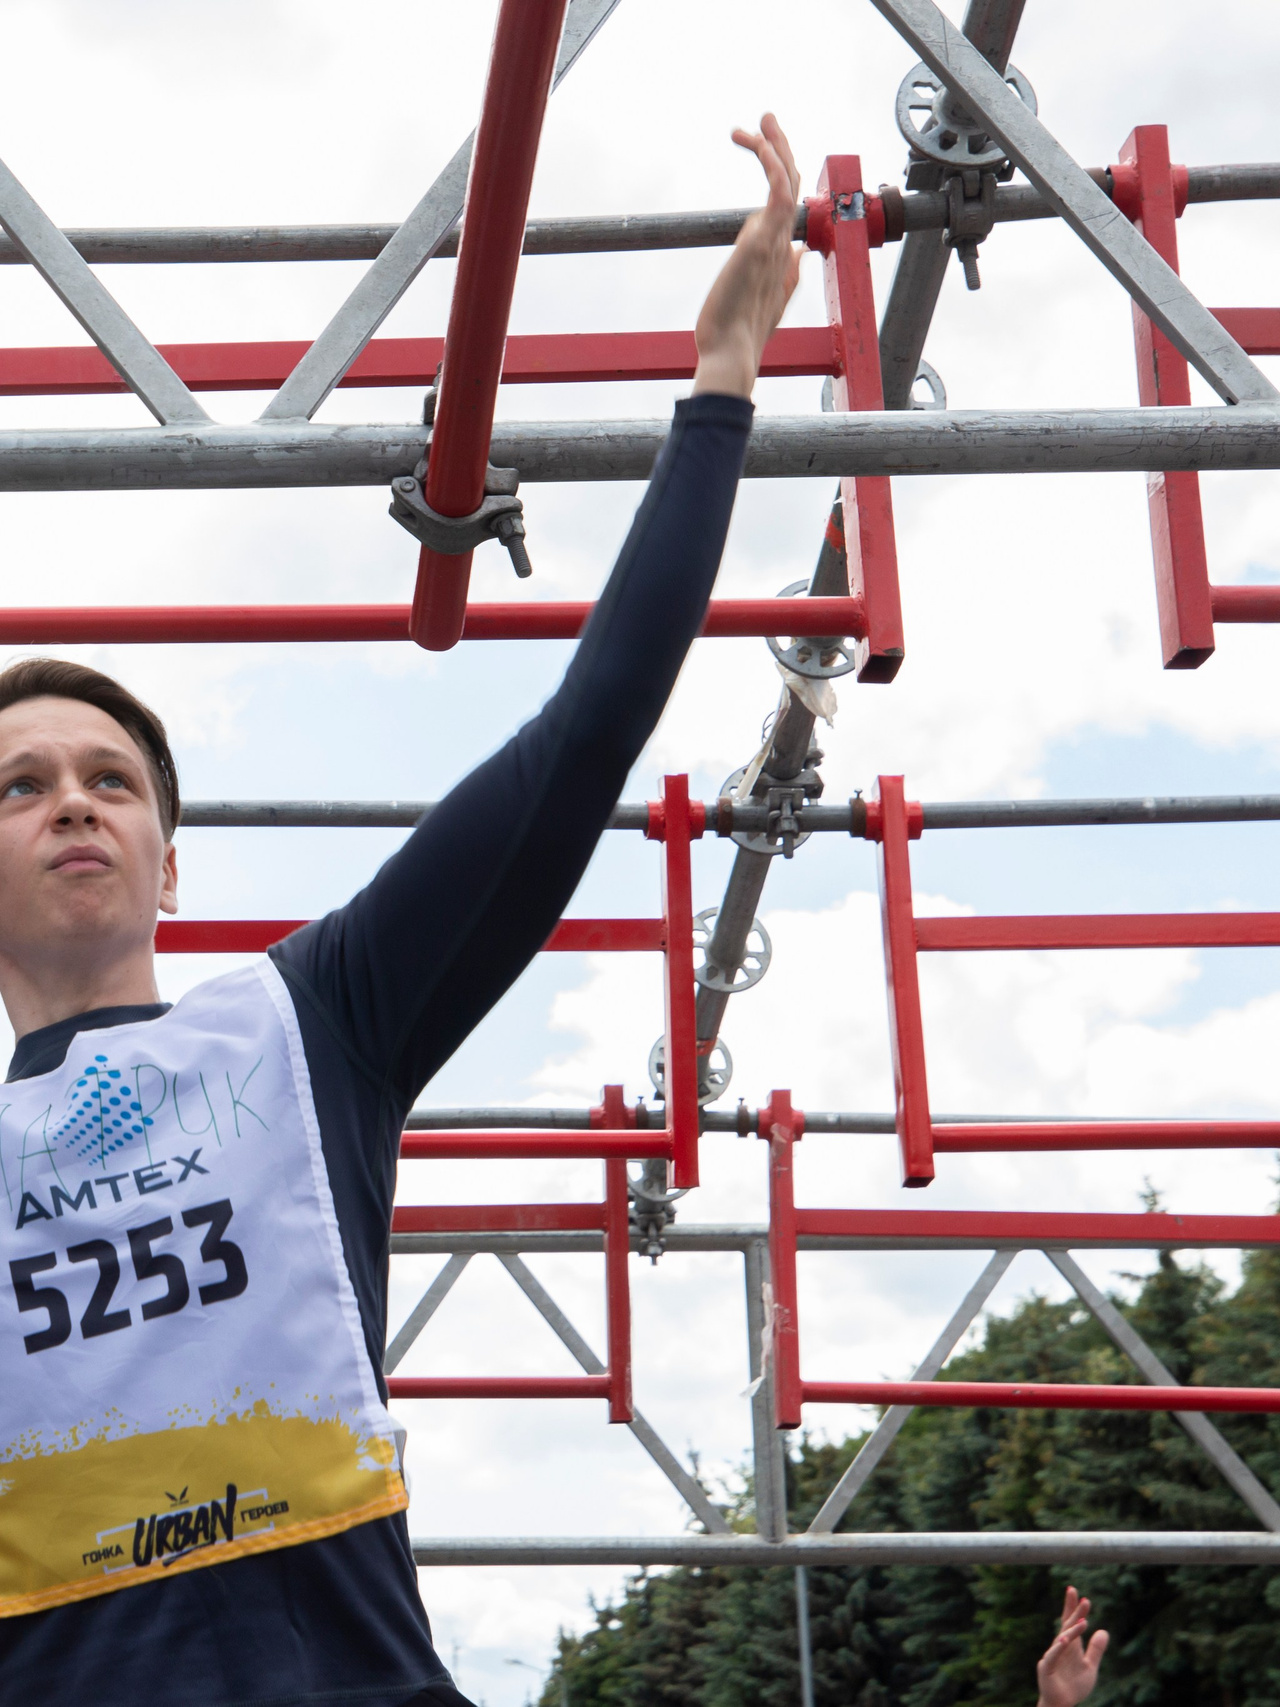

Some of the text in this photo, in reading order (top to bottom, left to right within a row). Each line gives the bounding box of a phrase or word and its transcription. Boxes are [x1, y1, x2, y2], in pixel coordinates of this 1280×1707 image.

[15, 1147, 211, 1230] AMTEX
[9, 1198, 249, 1355] 5253
[82, 1483, 290, 1567] ГОНКА URBAN ГЕРОЕВ
